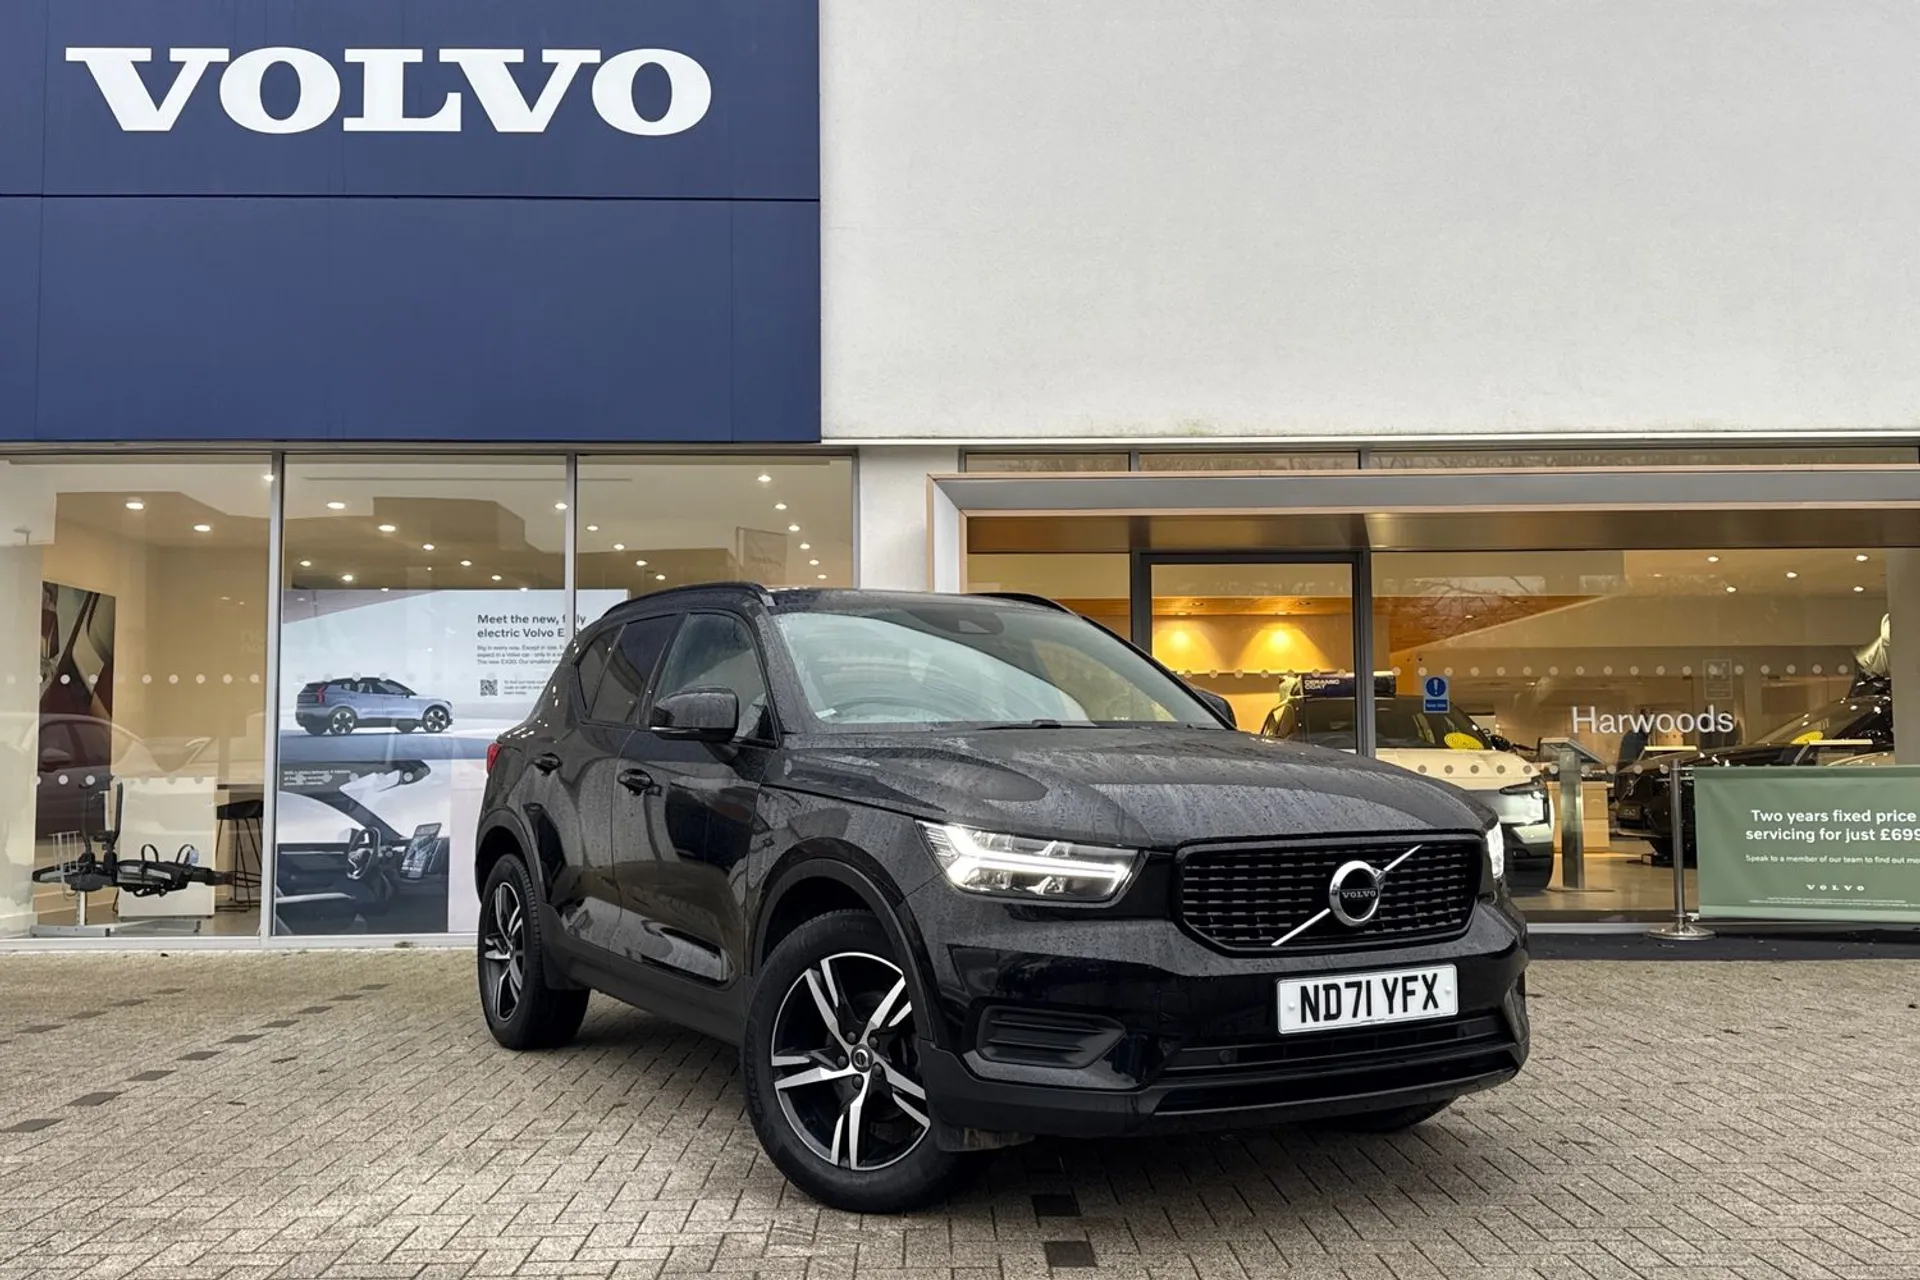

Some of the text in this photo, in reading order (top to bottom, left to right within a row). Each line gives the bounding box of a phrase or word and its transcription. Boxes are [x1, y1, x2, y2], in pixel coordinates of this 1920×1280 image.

[65, 46, 712, 136] VOLVO
[477, 614, 508, 624] Meet
[511, 614, 529, 624] the
[532, 615, 559, 625] new,
[477, 628, 520, 638] electric
[523, 628, 554, 638] Volvo
[1572, 704, 1734, 734] Harwoods
[1751, 809, 1917, 825] Two years fixed price
[1745, 828, 1920, 843] servicing for just £699
[1745, 854, 1769, 862] Speak
[1342, 890, 1376, 899] VOLVO
[1806, 884, 1865, 892] VOLVO
[1300, 973, 1439, 1023] ND71 YFX
